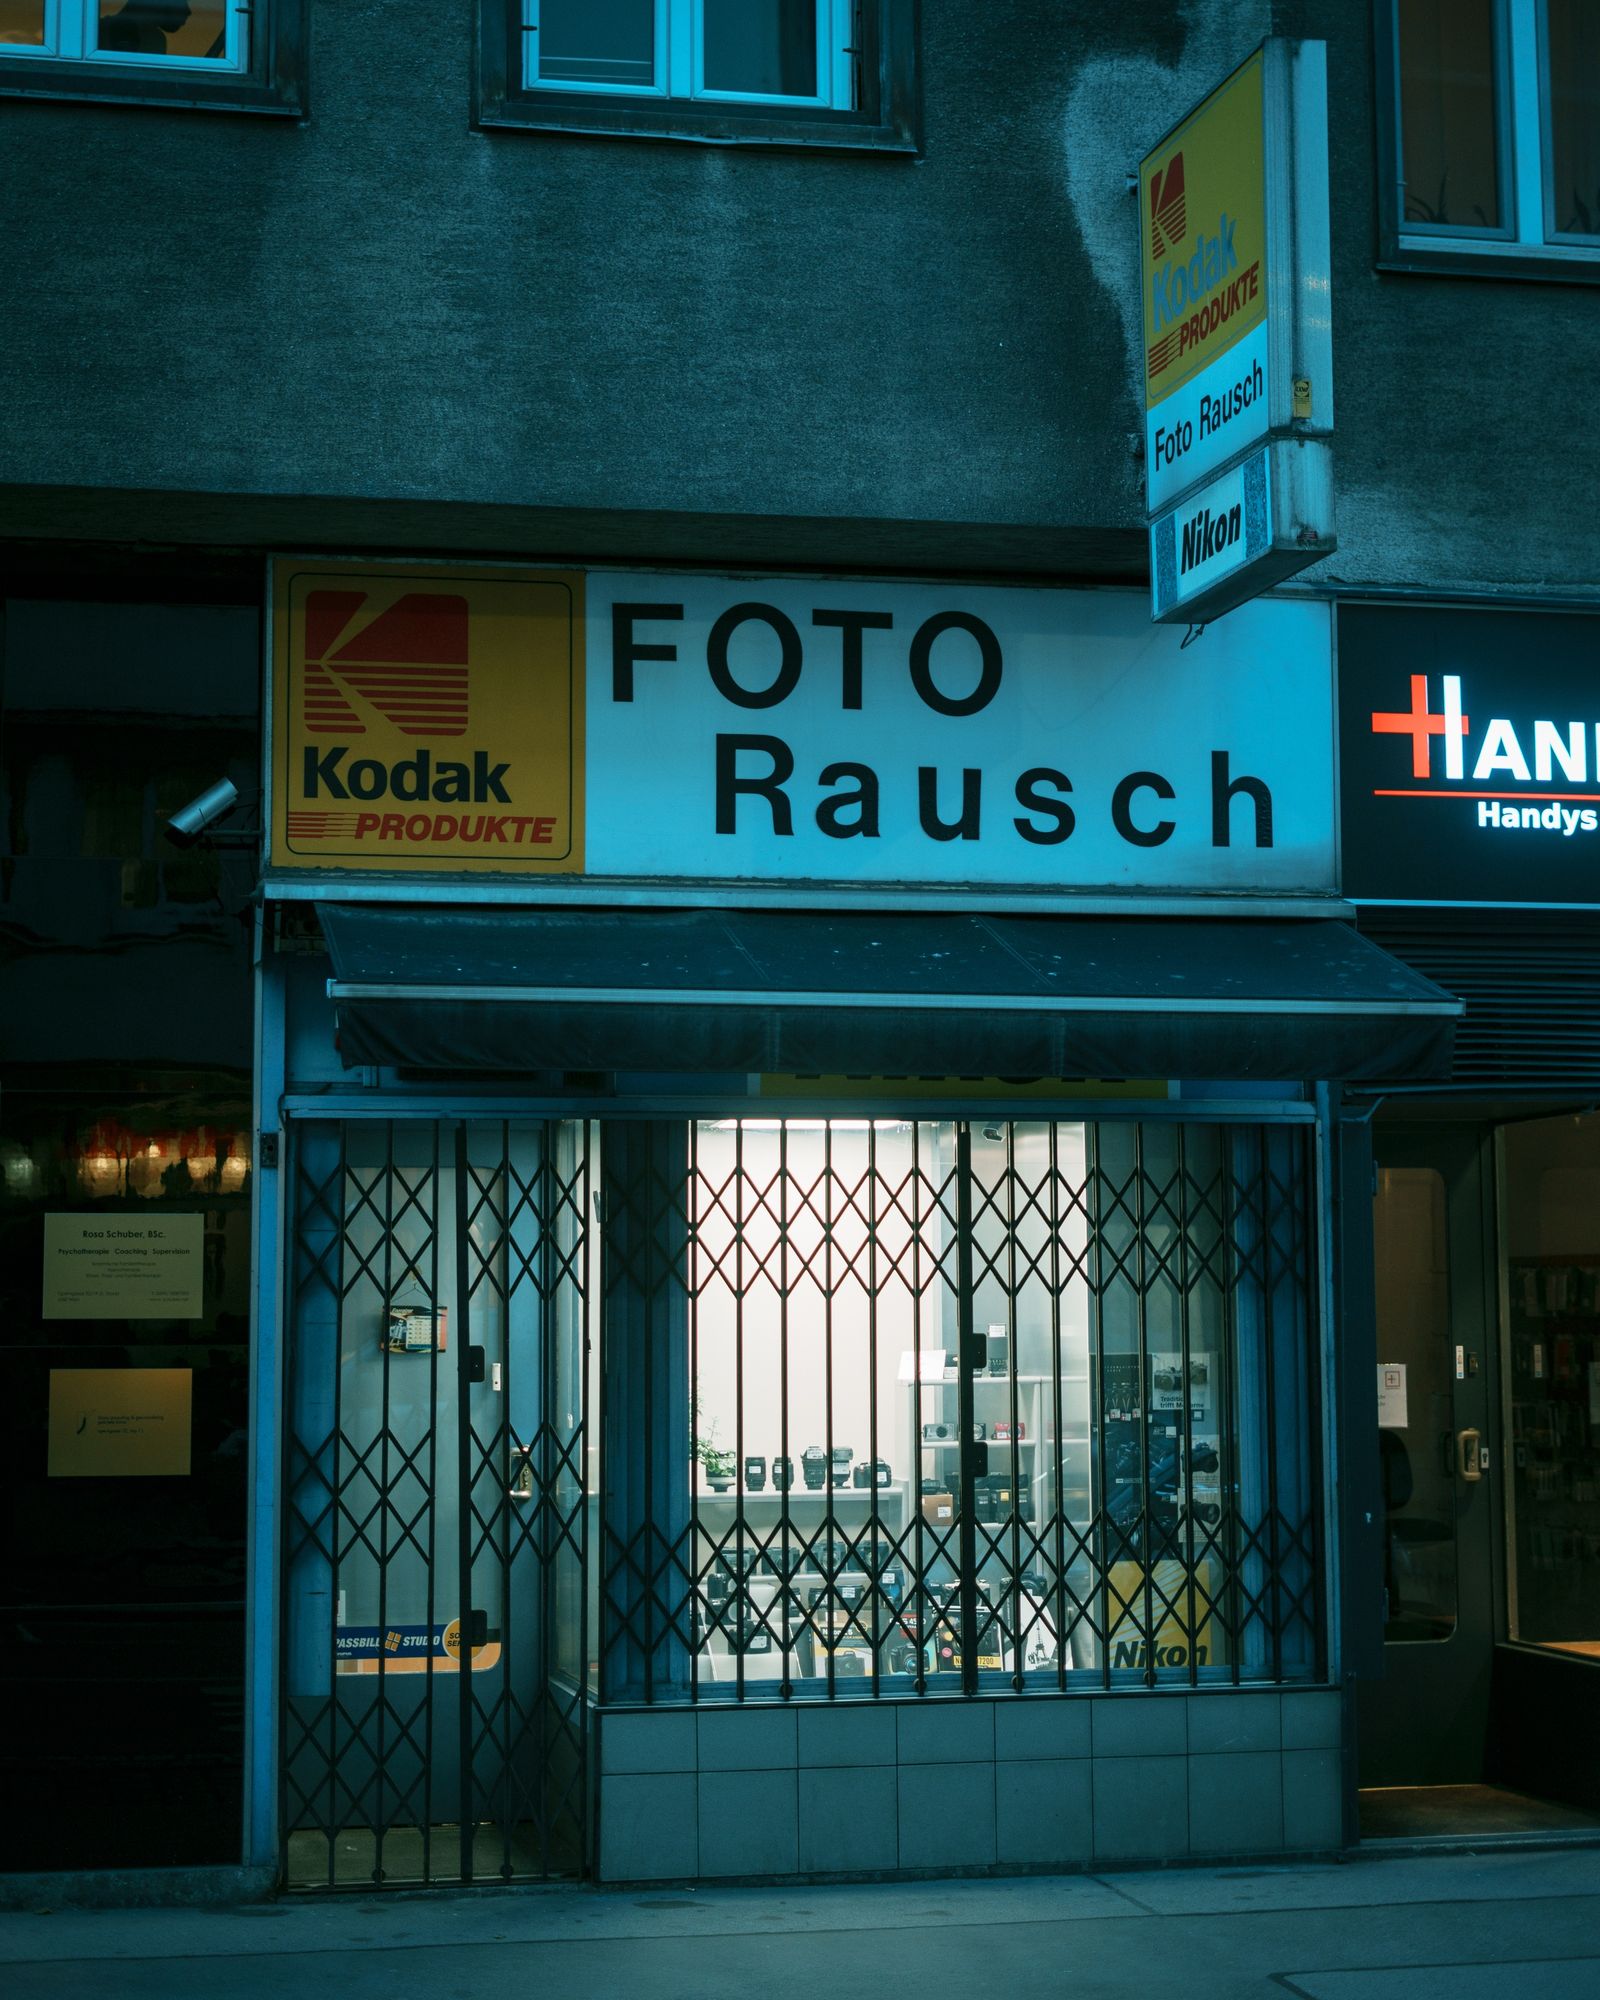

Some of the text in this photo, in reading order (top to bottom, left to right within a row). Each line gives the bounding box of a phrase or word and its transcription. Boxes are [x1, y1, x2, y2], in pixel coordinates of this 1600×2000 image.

[1152, 212, 1238, 333] Kodak
[1179, 260, 1260, 357] PRODUKTE
[1155, 358, 1263, 472] Foto Rausch
[1180, 503, 1241, 576] Nikon
[611, 600, 1002, 716] FOTO
[1371, 674, 1600, 783] HAN
[304, 746, 512, 804] Kodak
[717, 735, 1273, 847] Rausch
[354, 813, 556, 843] PRODUKTE
[1478, 801, 1599, 836] Handys
[58, 1248, 191, 1257] Psychotherapie Coaching Supervision
[82, 1230, 104, 1239] Rosa
[402, 1636, 440, 1647] STUDO
